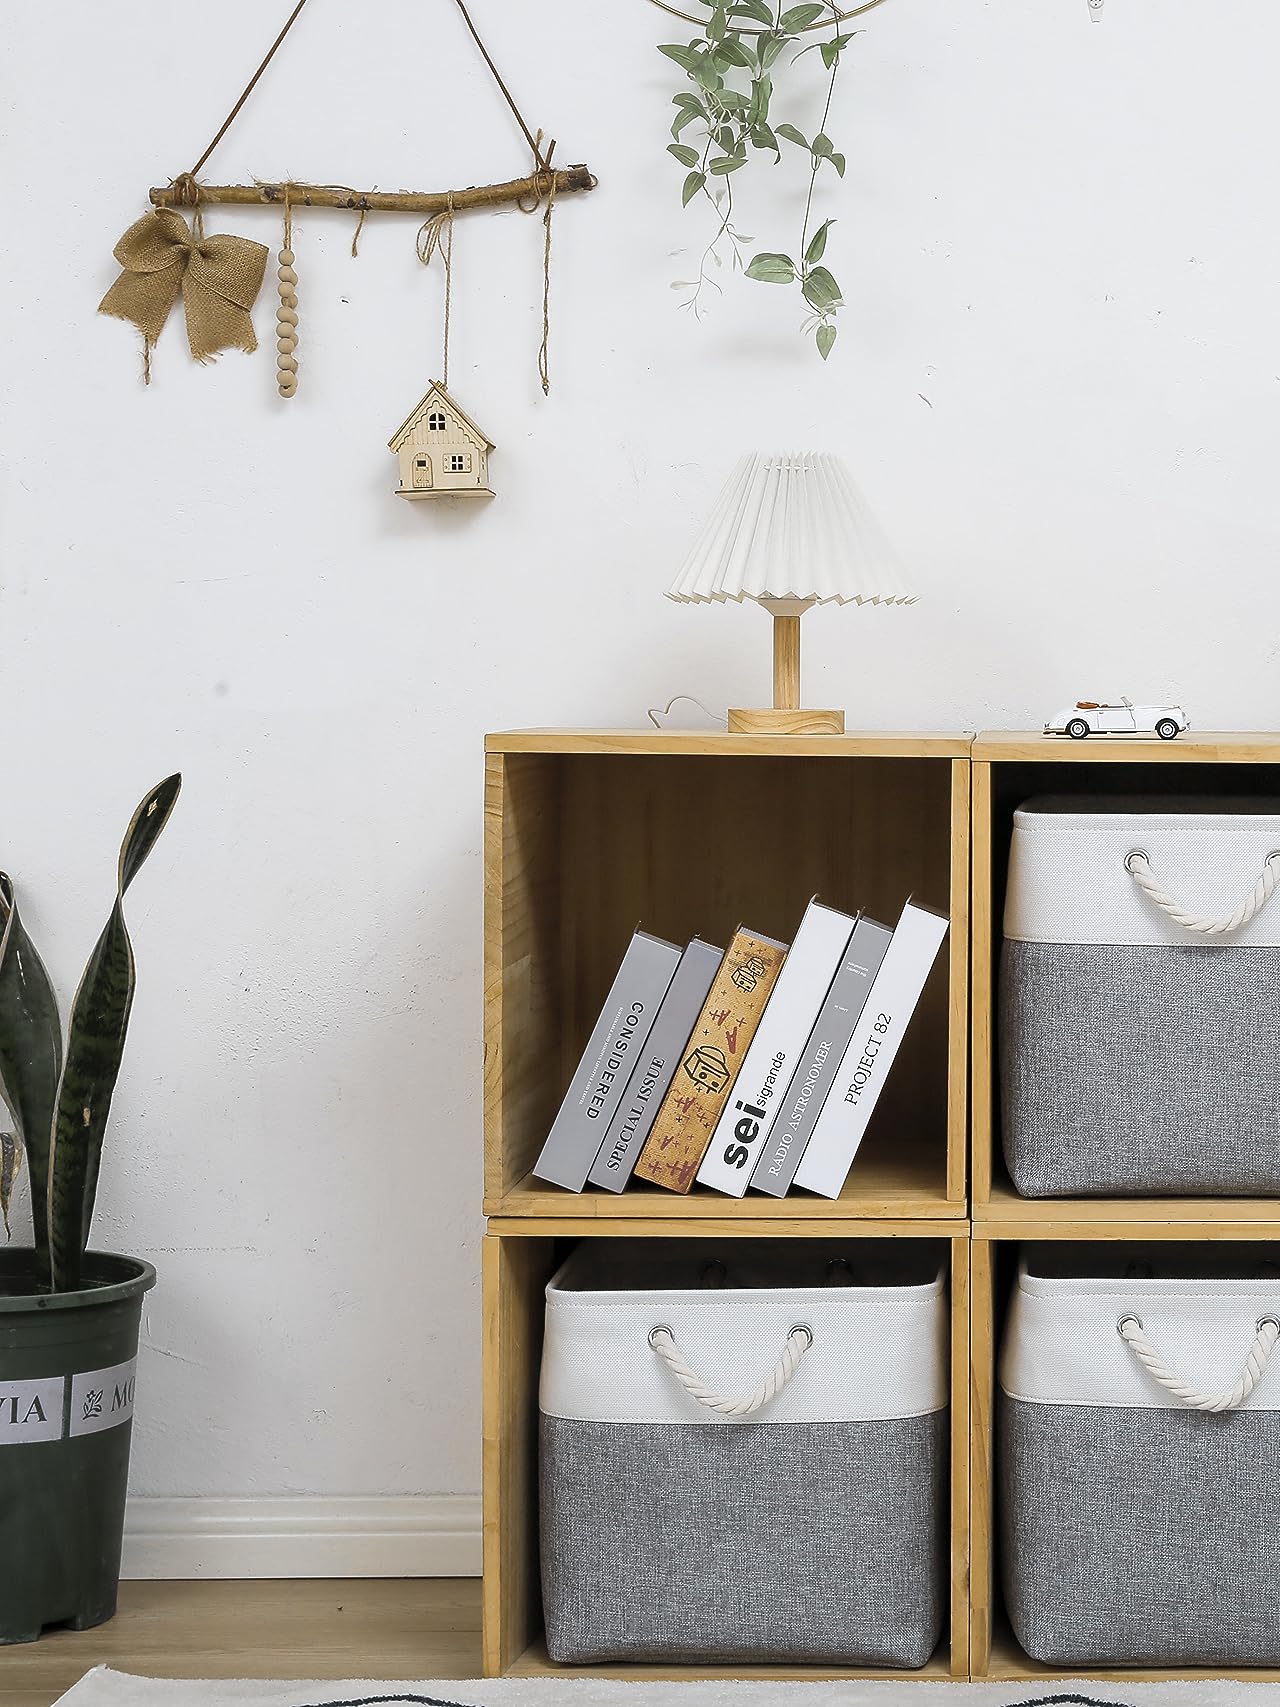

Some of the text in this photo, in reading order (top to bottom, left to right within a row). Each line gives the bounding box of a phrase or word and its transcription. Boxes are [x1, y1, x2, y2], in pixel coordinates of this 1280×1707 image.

[587, 1003, 643, 1118] CONSIDERED
[607, 1057, 665, 1171] SPECIAL ISSUE
[724, 1052, 785, 1169] sei sigrande
[768, 1042, 832, 1176] RADIO ASTRONOMER
[844, 1013, 891, 1105] PROJECT 82
